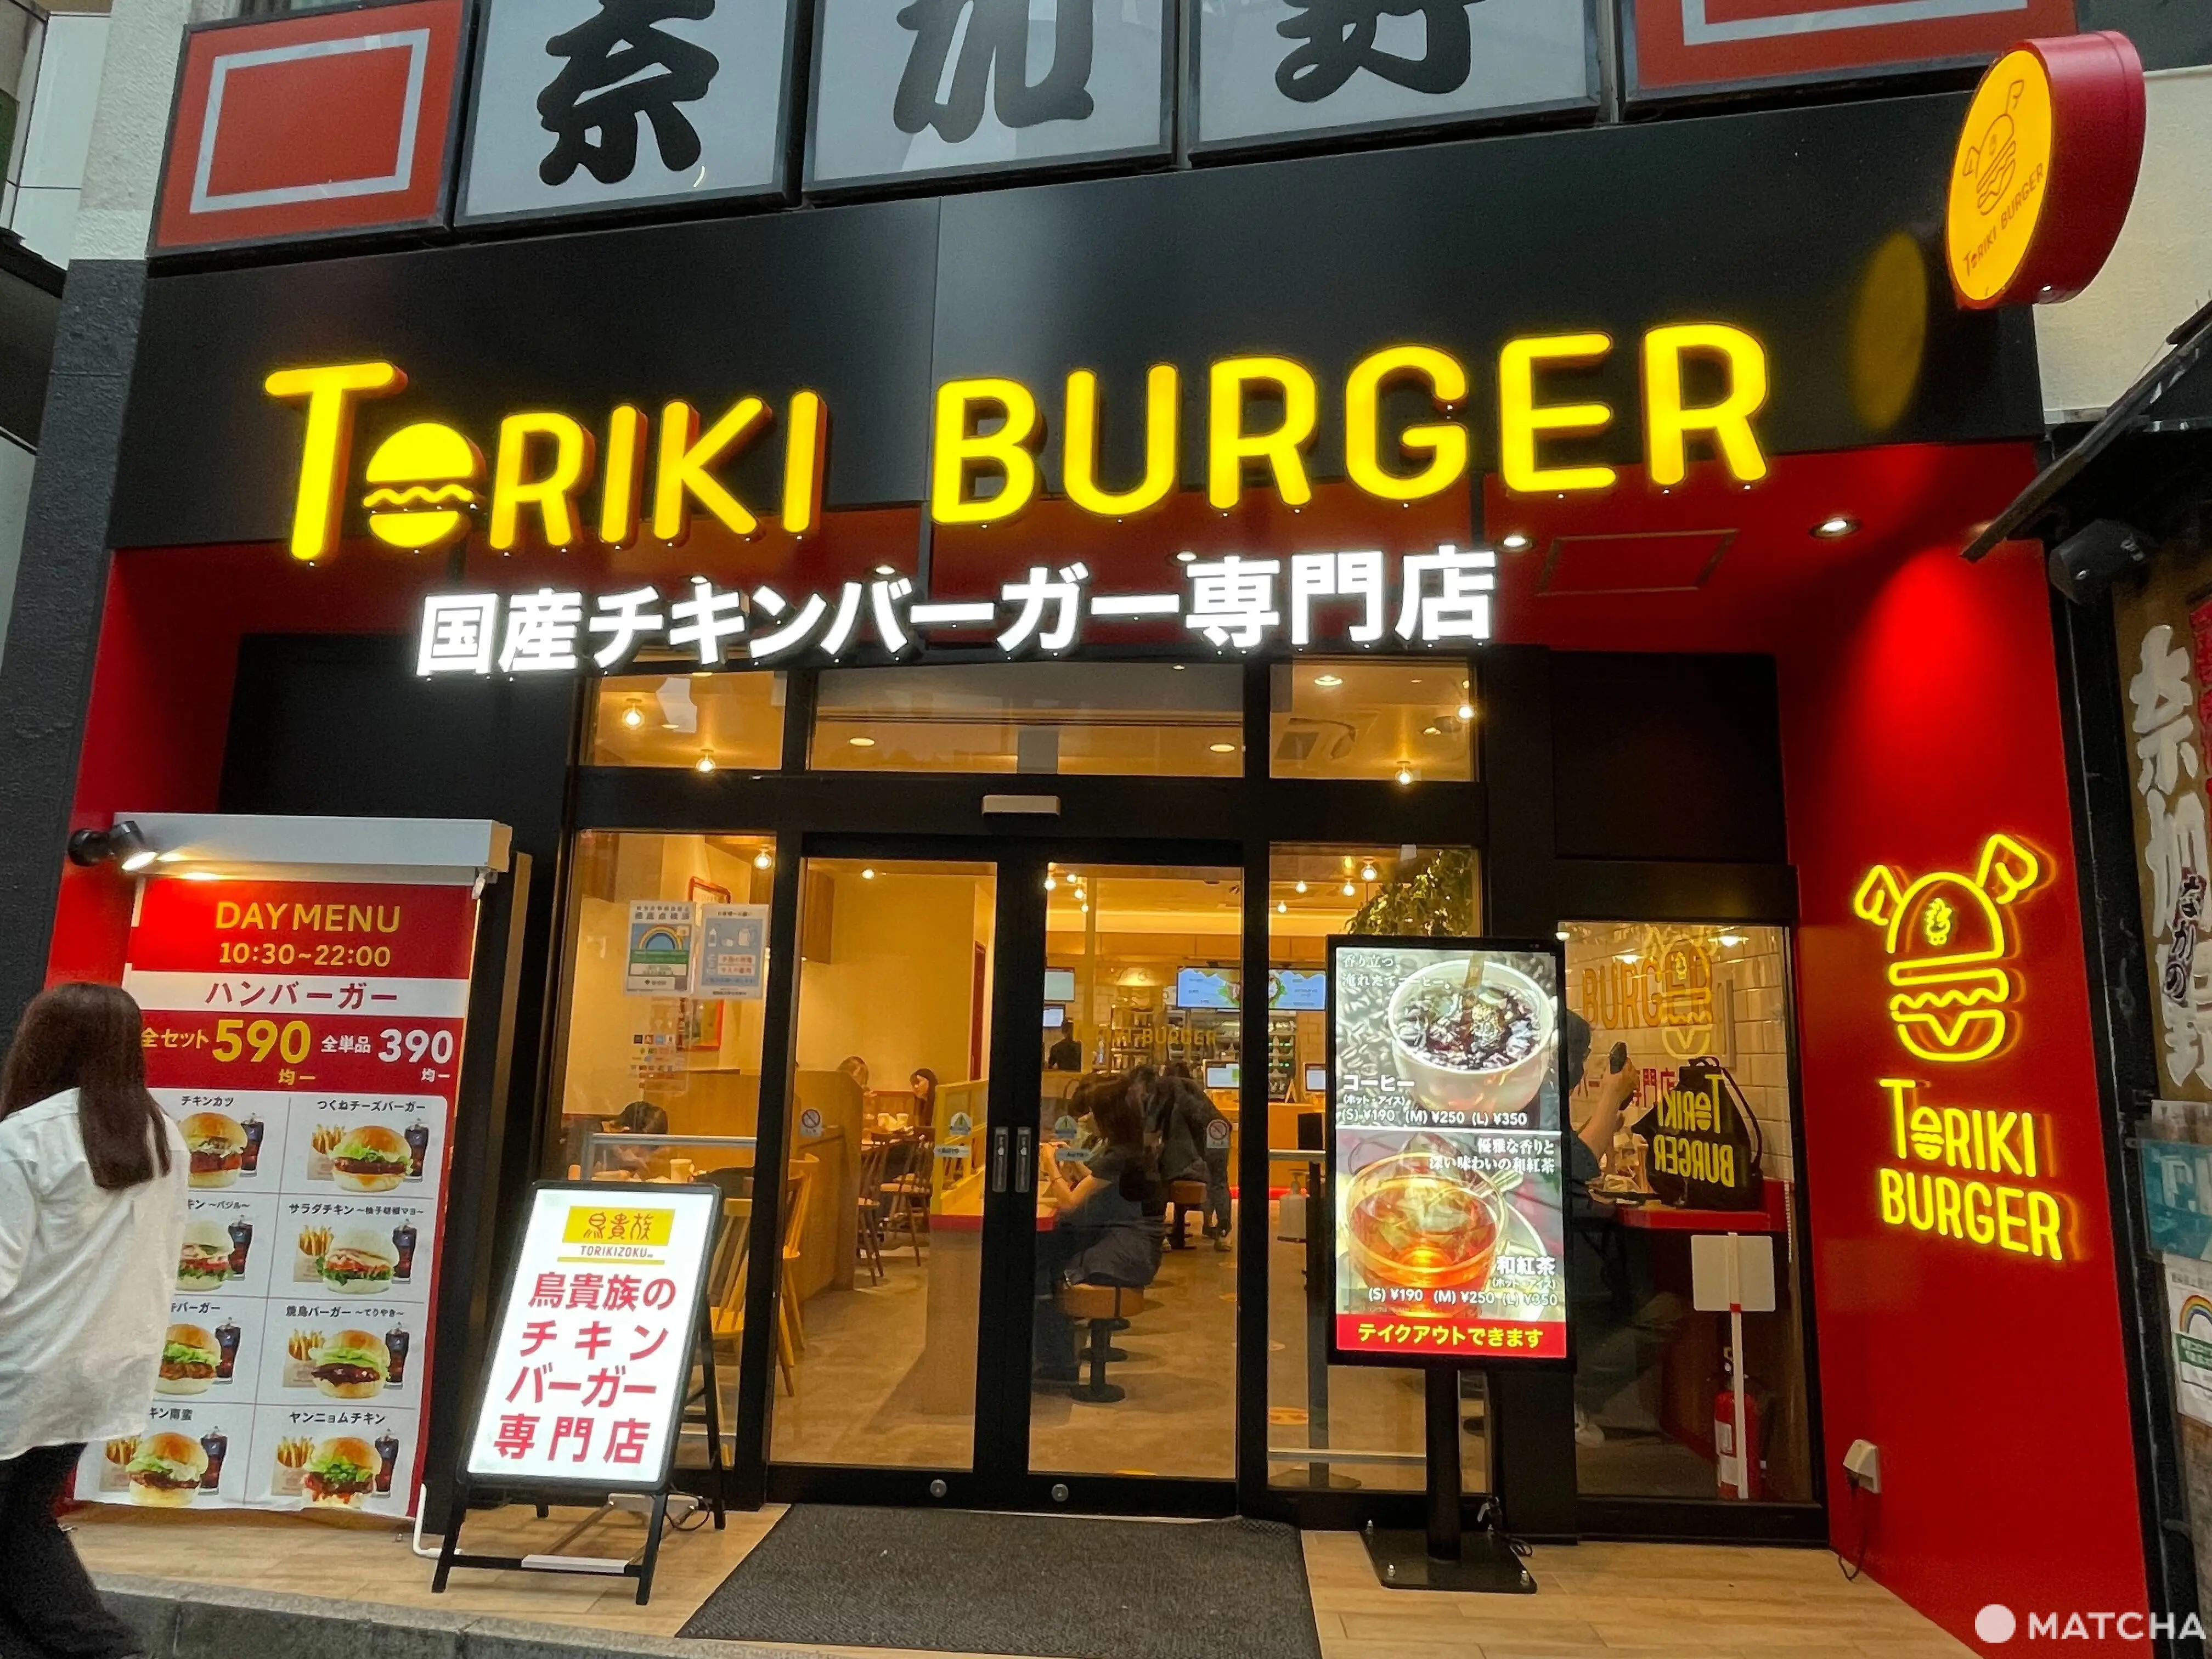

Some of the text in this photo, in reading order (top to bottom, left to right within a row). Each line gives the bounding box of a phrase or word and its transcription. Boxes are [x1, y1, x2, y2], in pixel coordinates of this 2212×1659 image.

[2000, 163, 2044, 230] BURGER
[930, 323, 1769, 526] BURGER
[416, 543, 1498, 676] 国産チキンバーガー専門店
[205, 980, 397, 1009] ハンバーガー
[1582, 951, 1713, 1029] BURGER
[141, 1019, 453, 1064] 全セット 590 全単品 390
[278, 1069, 316, 1085] 均一
[1343, 1074, 1415, 1092] コーヒー
[180, 1095, 234, 1107] チキンカツ
[317, 1100, 426, 1113] つくねチーズバーガー
[1342, 1108, 1528, 1126] (S) ¥190 (M) ¥250 (L) ¥350
[1477, 1137, 1555, 1155] 優雅な香りと
[1429, 1154, 1555, 1175] 深い味わいの和紅茶
[289, 1204, 354, 1215] サラダチキン
[1880, 1166, 2064, 1262] BURGER
[580, 1245, 648, 1258] TORIKIZOKU
[1497, 1256, 1556, 1276] 和紅茶
[528, 1271, 676, 1312] 鳥貴族の
[1368, 1288, 1386, 1302] (S)
[1390, 1288, 1423, 1302] ¥190
[1433, 1289, 1457, 1305] (M)
[1460, 1290, 1495, 1305] ¥250
[1502, 1293, 1520, 1306] (L)
[520, 1319, 668, 1362] チキン
[1358, 1323, 1544, 1348] テイクアウトできます
[506, 1362, 657, 1408] バーガー
[289, 1412, 385, 1425] ヤンニョムチキン
[494, 1412, 651, 1464] 専門店
